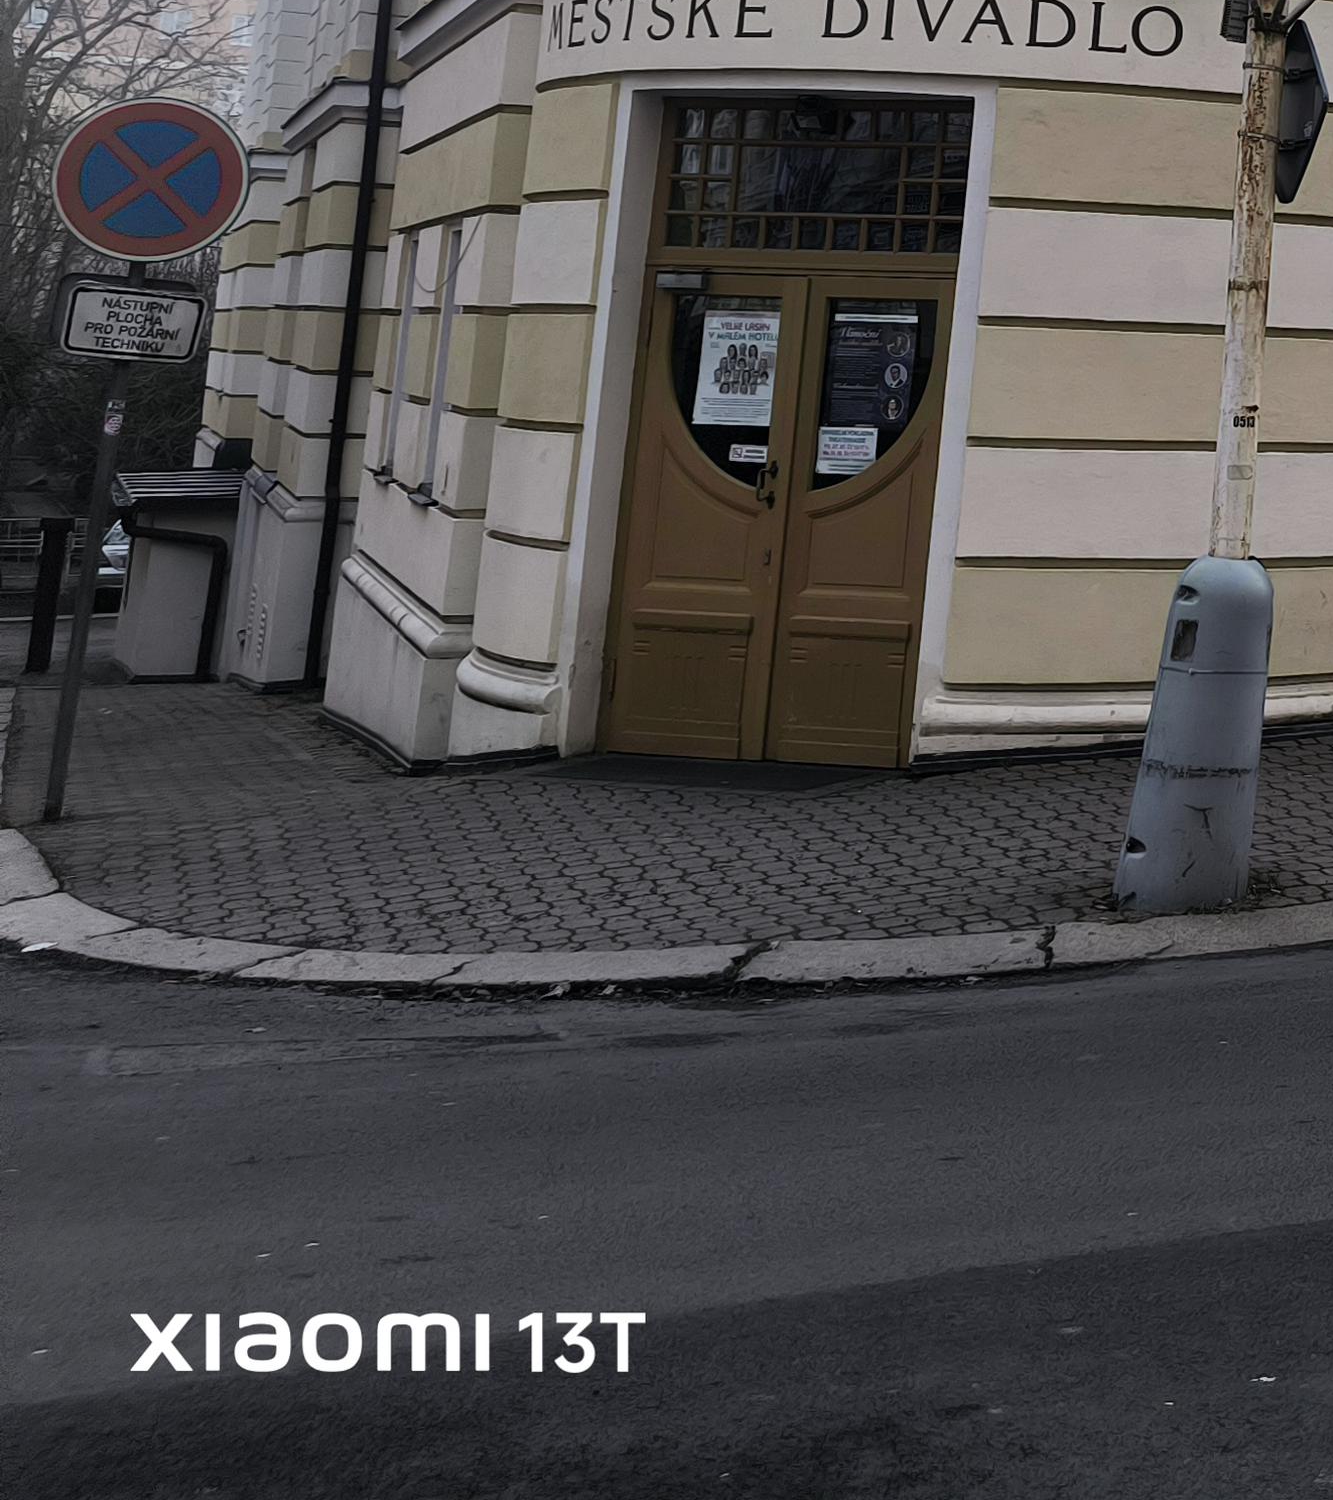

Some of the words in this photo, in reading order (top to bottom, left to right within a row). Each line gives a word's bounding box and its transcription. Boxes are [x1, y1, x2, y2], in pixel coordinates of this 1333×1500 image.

[101, 296, 176, 315] NÁSTUPNÍ
[106, 310, 163, 327] PLOCHA
[84, 321, 114, 335] PRO
[93, 336, 165, 353] TECHNIKU
